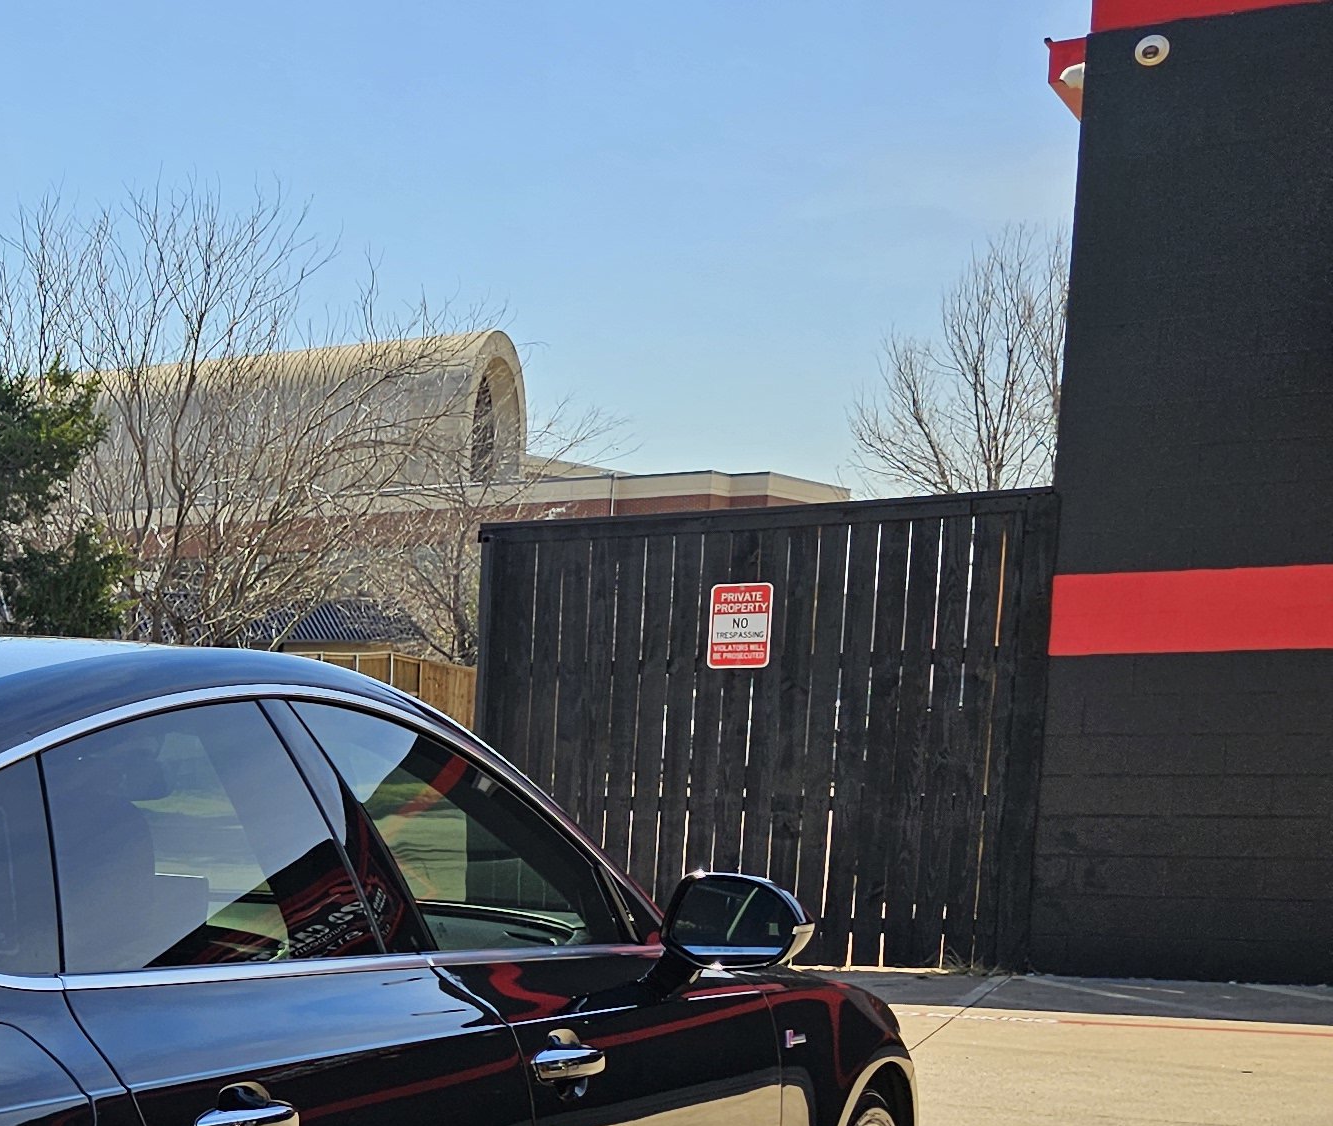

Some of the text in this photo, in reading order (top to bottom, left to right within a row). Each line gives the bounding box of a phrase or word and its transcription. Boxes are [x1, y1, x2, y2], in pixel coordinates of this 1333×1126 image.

[721, 591, 763, 602] PRIVATE
[714, 602, 768, 613] PROPERTY
[732, 617, 749, 629] NO
[716, 631, 764, 639] TRESPASSING
[713, 644, 749, 652] VIOLATORS
